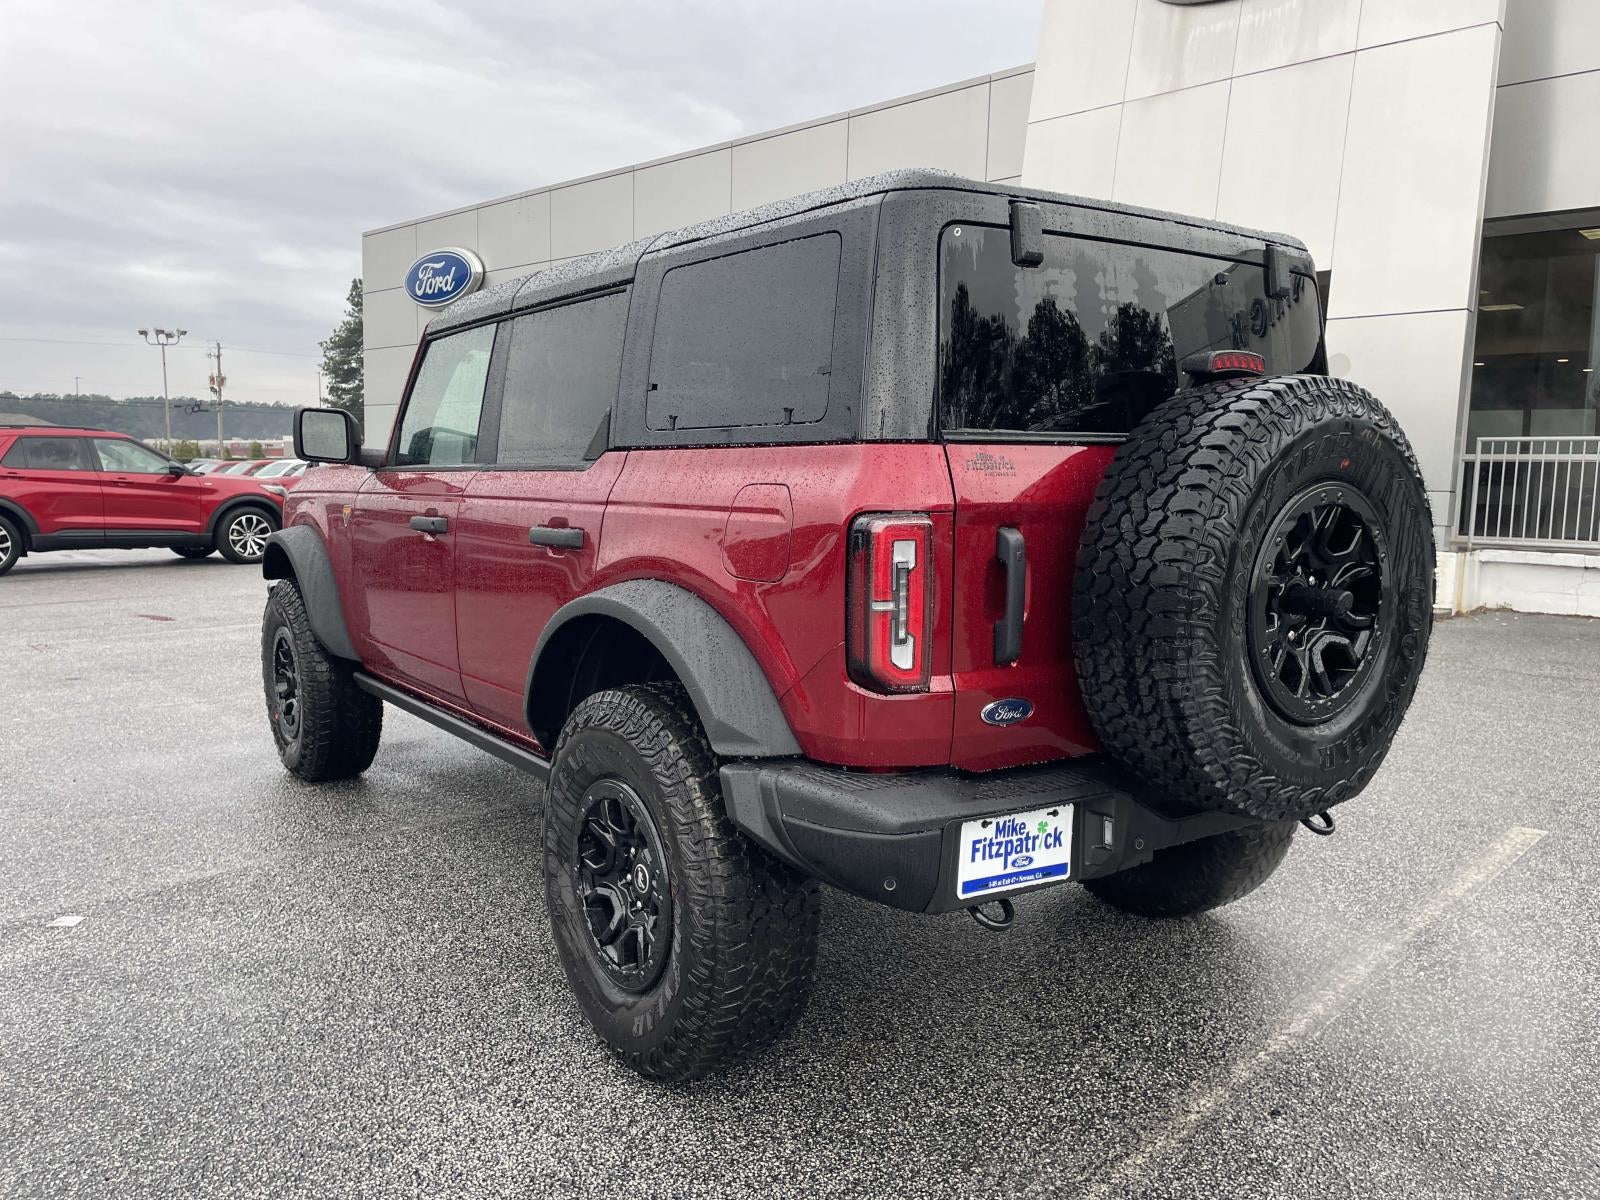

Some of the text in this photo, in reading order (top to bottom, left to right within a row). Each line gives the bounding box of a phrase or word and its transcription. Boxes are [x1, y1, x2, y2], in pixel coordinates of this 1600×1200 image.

[415, 260, 456, 296] Ford
[995, 705, 1023, 720] Ford
[995, 817, 1027, 840] Mike
[971, 826, 1063, 870] Fitzpatrick
